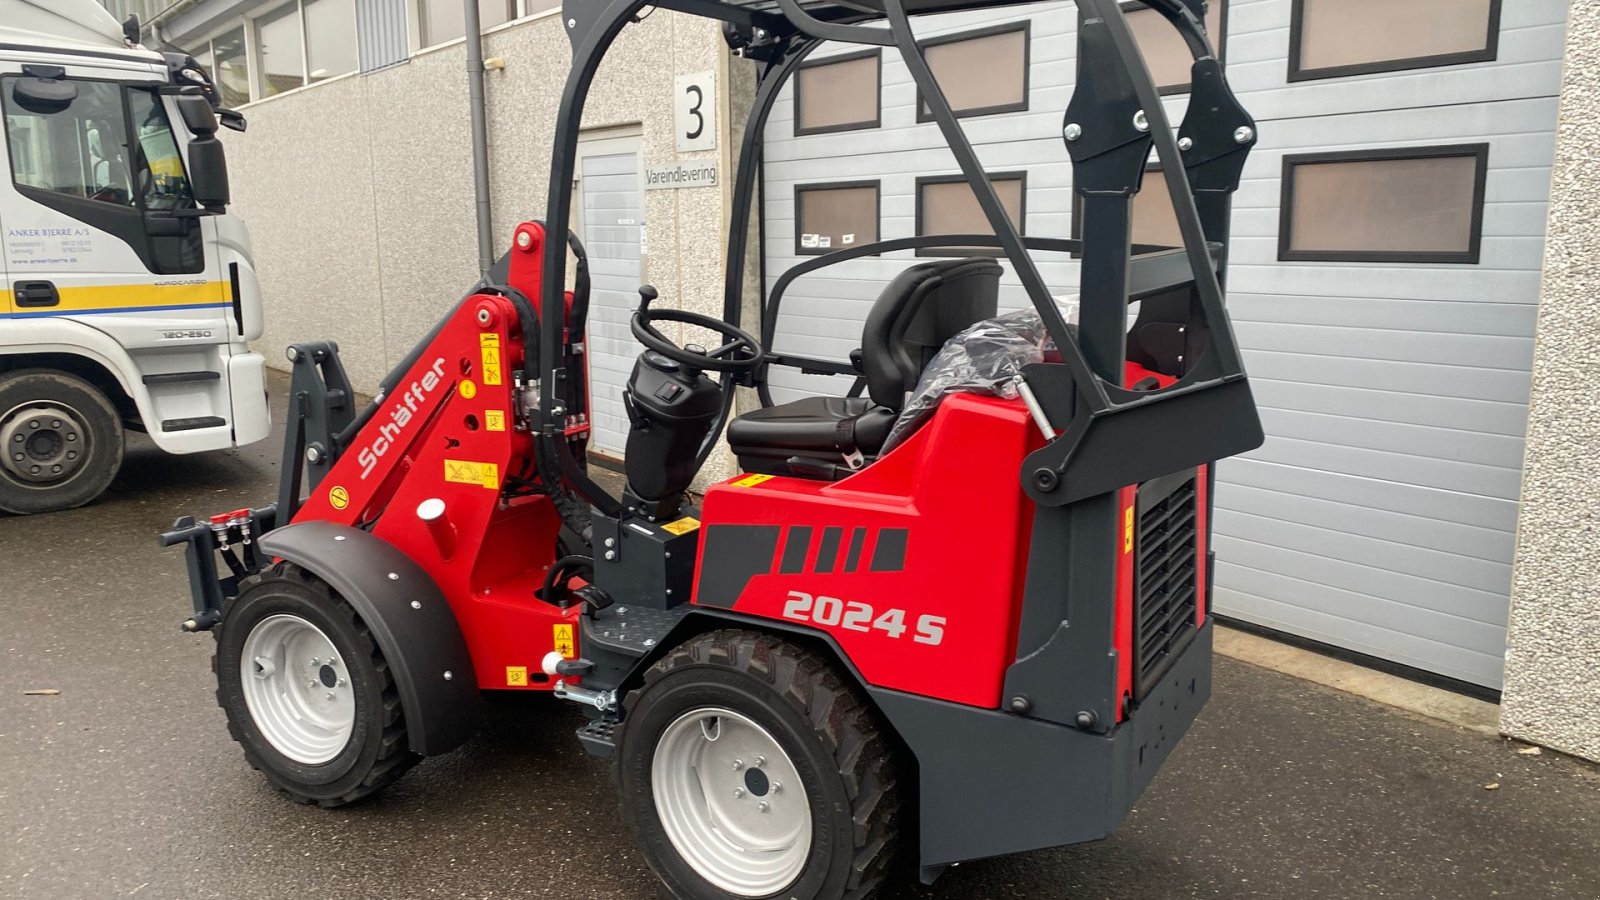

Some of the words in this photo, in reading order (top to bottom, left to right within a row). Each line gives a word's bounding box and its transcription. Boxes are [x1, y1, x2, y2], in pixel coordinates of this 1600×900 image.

[686, 84, 704, 140] 3
[645, 163, 716, 185] Vareindlevering
[8, 229, 40, 237] ANKER
[42, 228, 73, 237] BJERRE
[74, 228, 90, 236] A/S
[163, 330, 212, 339] 120-250
[357, 357, 446, 480] Schäffer
[783, 590, 906, 639] 2024
[913, 613, 947, 646] S
